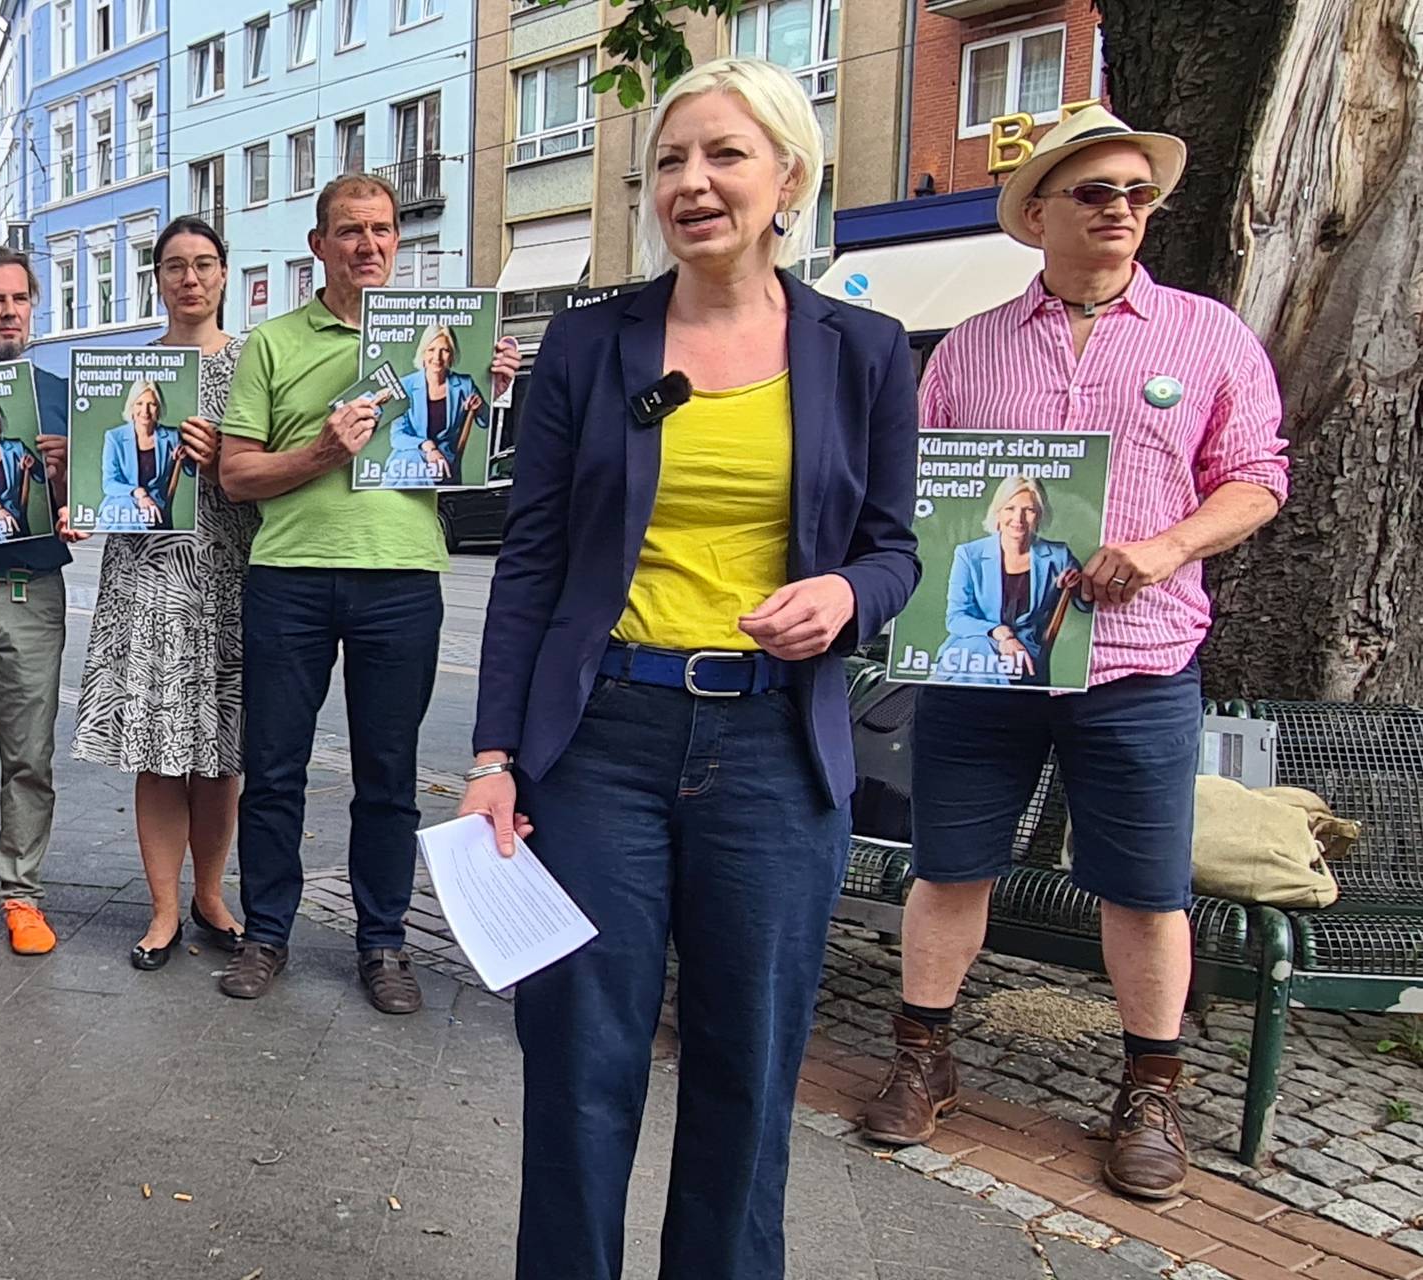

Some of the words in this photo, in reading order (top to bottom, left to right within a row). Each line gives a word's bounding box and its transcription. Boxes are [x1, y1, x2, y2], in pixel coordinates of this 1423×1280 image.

[368, 295, 427, 310] Kümmert
[428, 295, 455, 310] sich
[456, 295, 482, 310] mal
[367, 311, 414, 328] jemand
[416, 314, 437, 326] um
[439, 312, 473, 326] mein
[367, 327, 415, 342] Viertel?
[75, 352, 133, 367] Kümmert
[135, 352, 159, 367] sich
[161, 353, 185, 367] mal
[75, 367, 122, 383] jemand
[123, 370, 144, 382] um
[145, 368, 177, 382] mein
[75, 383, 123, 397] Viertel?
[917, 437, 1004, 457] Kümmert
[1006, 438, 1045, 458] sich
[1048, 440, 1086, 458] mal
[360, 458, 387, 480] Ja,
[389, 458, 444, 479] Clara!
[988, 463, 1020, 478] um
[1022, 461, 1071, 479] mein
[915, 479, 986, 498] Viertel?
[73, 504, 101, 524] Ja,
[102, 504, 156, 523] Clara!
[896, 645, 939, 674] Ja,
[942, 646, 1025, 675] Clara!
